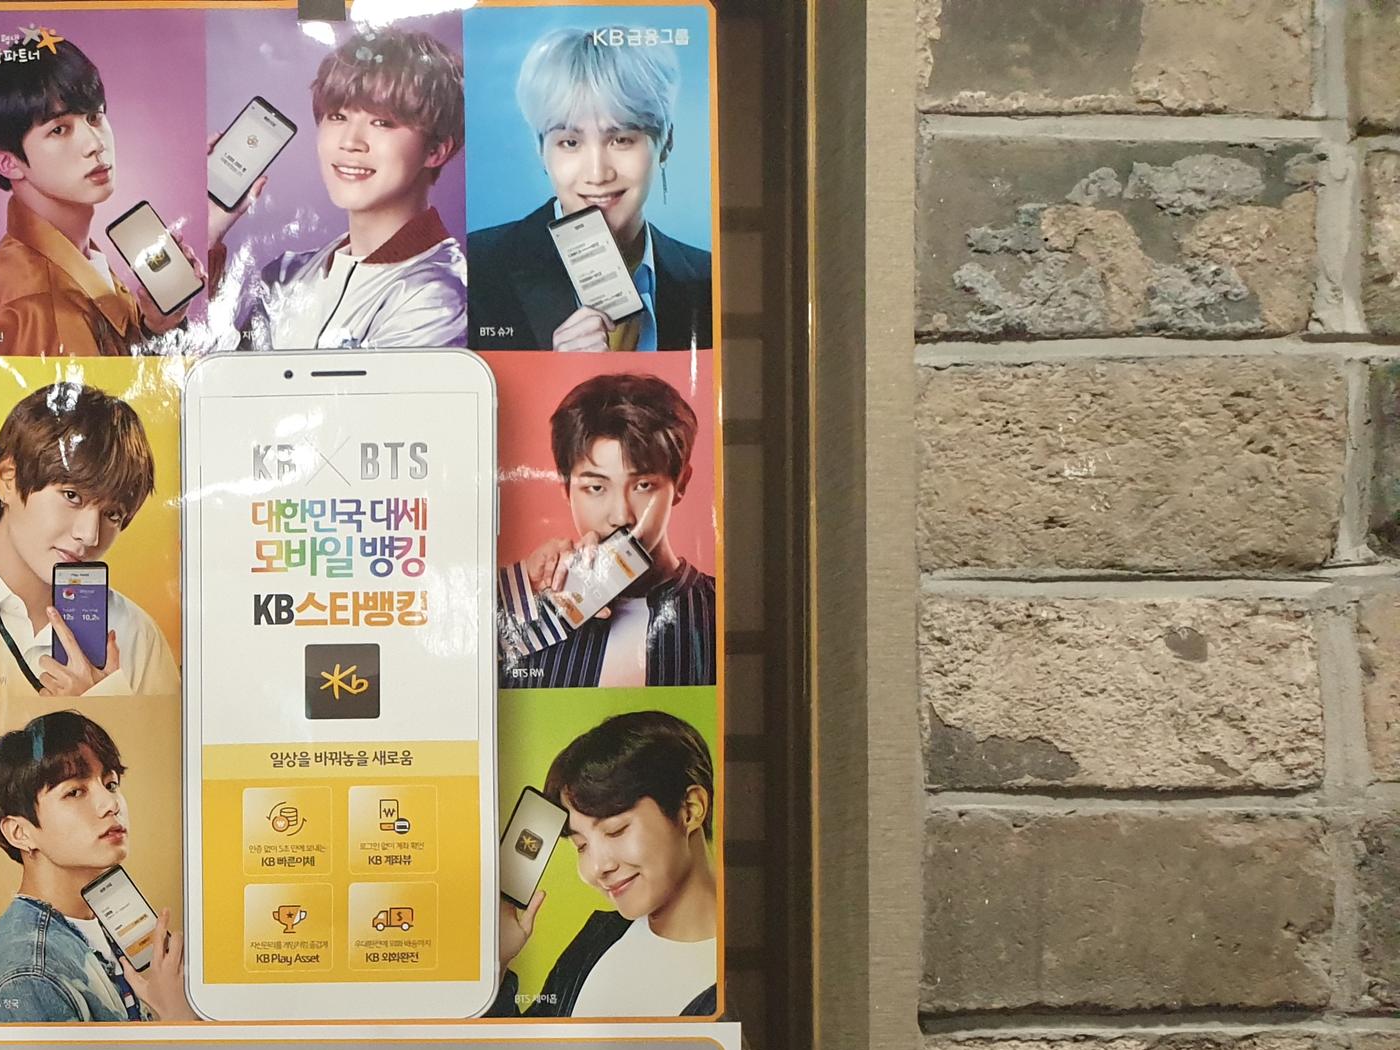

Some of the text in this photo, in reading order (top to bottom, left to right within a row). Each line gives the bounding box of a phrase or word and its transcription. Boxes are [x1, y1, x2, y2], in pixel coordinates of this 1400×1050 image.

[479, 326, 514, 337] BTS 슈가
[360, 442, 428, 480] BTS
[251, 497, 428, 533] 대한민국 대세
[251, 535, 426, 578] 모바일 뱅킹
[253, 591, 428, 626] KB스타뱅킹
[512, 668, 544, 678] BTS RM
[270, 749, 413, 768] 일상을 바꿔놓을 새로움
[261, 857, 275, 867] KB
[368, 855, 382, 865] KB
[256, 953, 320, 966] KB Play Asset
[365, 951, 419, 963] KB 외화환전
